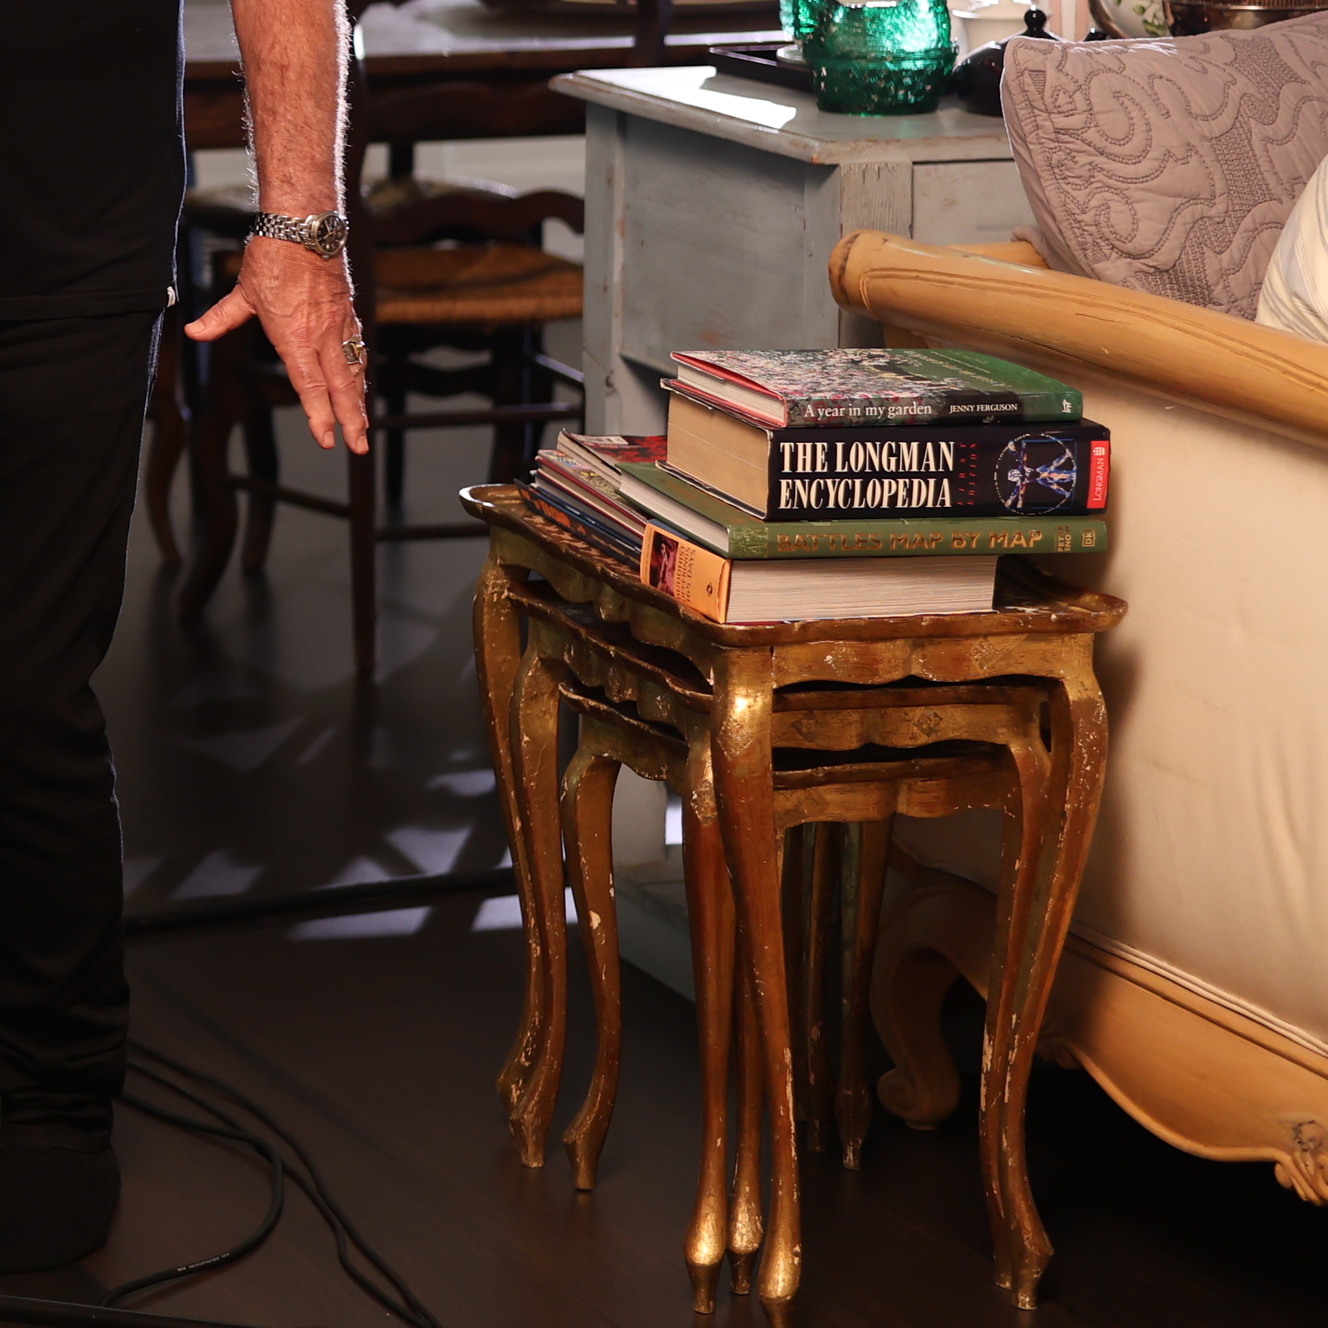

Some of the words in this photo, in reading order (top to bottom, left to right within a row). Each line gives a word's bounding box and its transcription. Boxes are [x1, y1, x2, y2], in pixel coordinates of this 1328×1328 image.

[804, 404, 815, 417] A
[817, 407, 846, 420] year
[848, 403, 861, 416] in
[865, 406, 885, 419] my
[887, 401, 932, 419] garden
[949, 404, 975, 414] JENNY
[976, 403, 1018, 412] FERGUSON
[779, 441, 829, 473] THE
[834, 441, 955, 473] LONGMAN
[778, 477, 952, 510] ENCYCLOPEDIA
[1093, 457, 1105, 502] LONGMAN
[776, 532, 883, 553] BATTLES
[889, 531, 944, 550] MAP
[951, 531, 982, 549] BY
[988, 529, 1043, 549] MAP
[1064, 524, 1072, 552] SNOW
